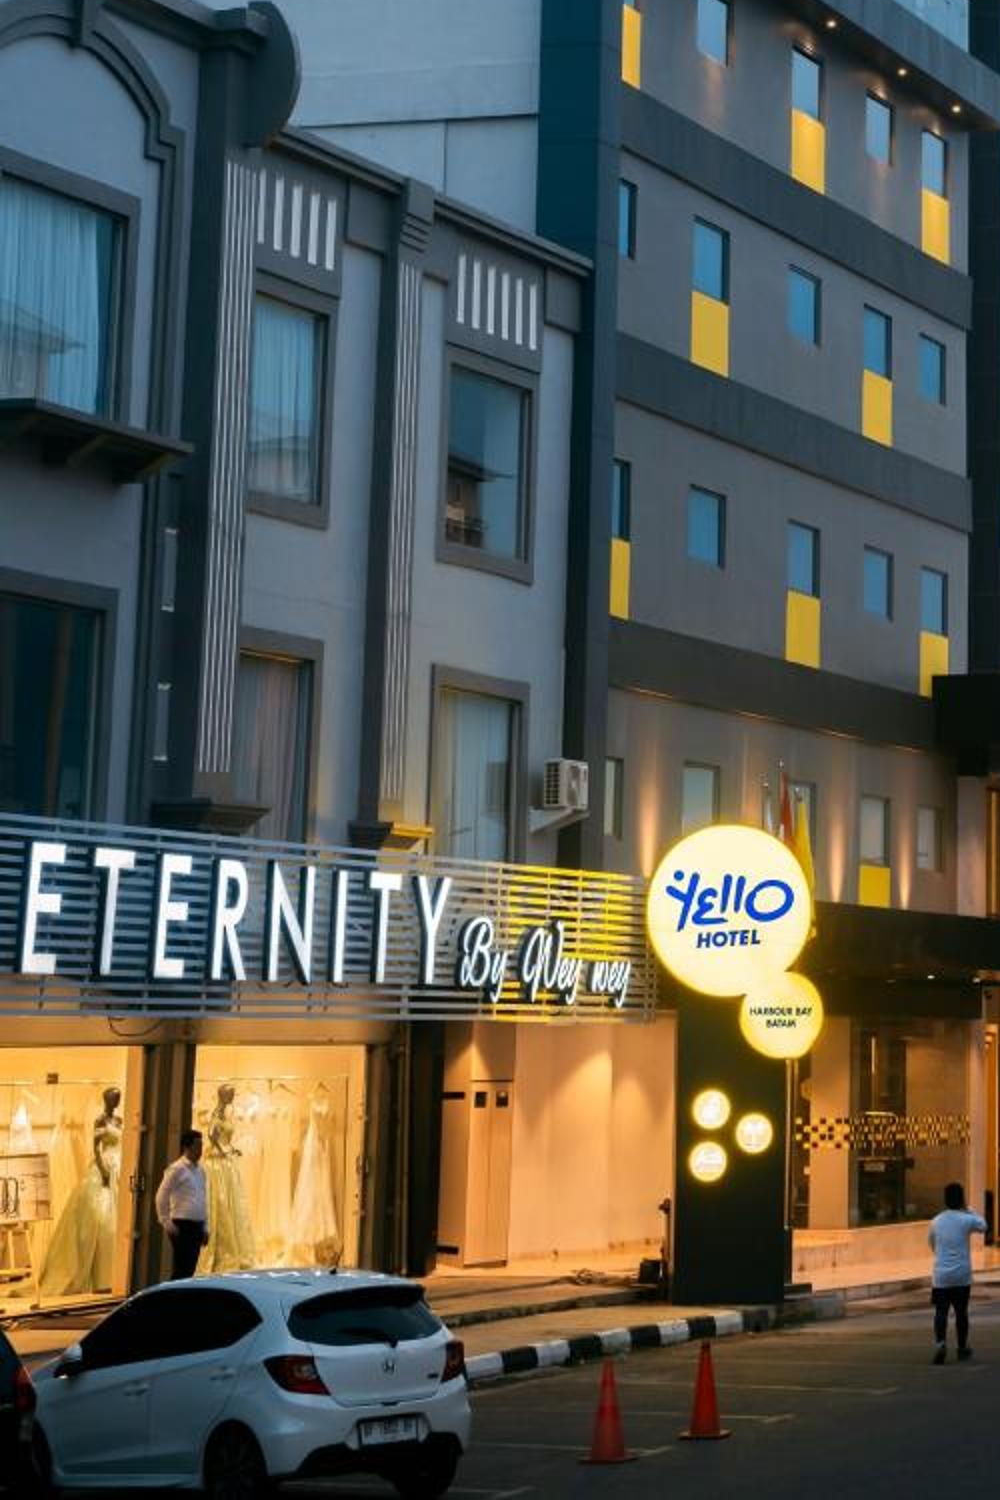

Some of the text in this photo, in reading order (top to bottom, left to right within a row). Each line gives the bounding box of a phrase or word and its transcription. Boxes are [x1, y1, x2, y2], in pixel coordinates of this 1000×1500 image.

[20, 842, 452, 984] ETERNITY
[461, 916, 507, 1003] By
[696, 928, 761, 949] HOTEL
[750, 1006, 812, 1017] HARBOUR BAY
[766, 1019, 797, 1028] BATAM
